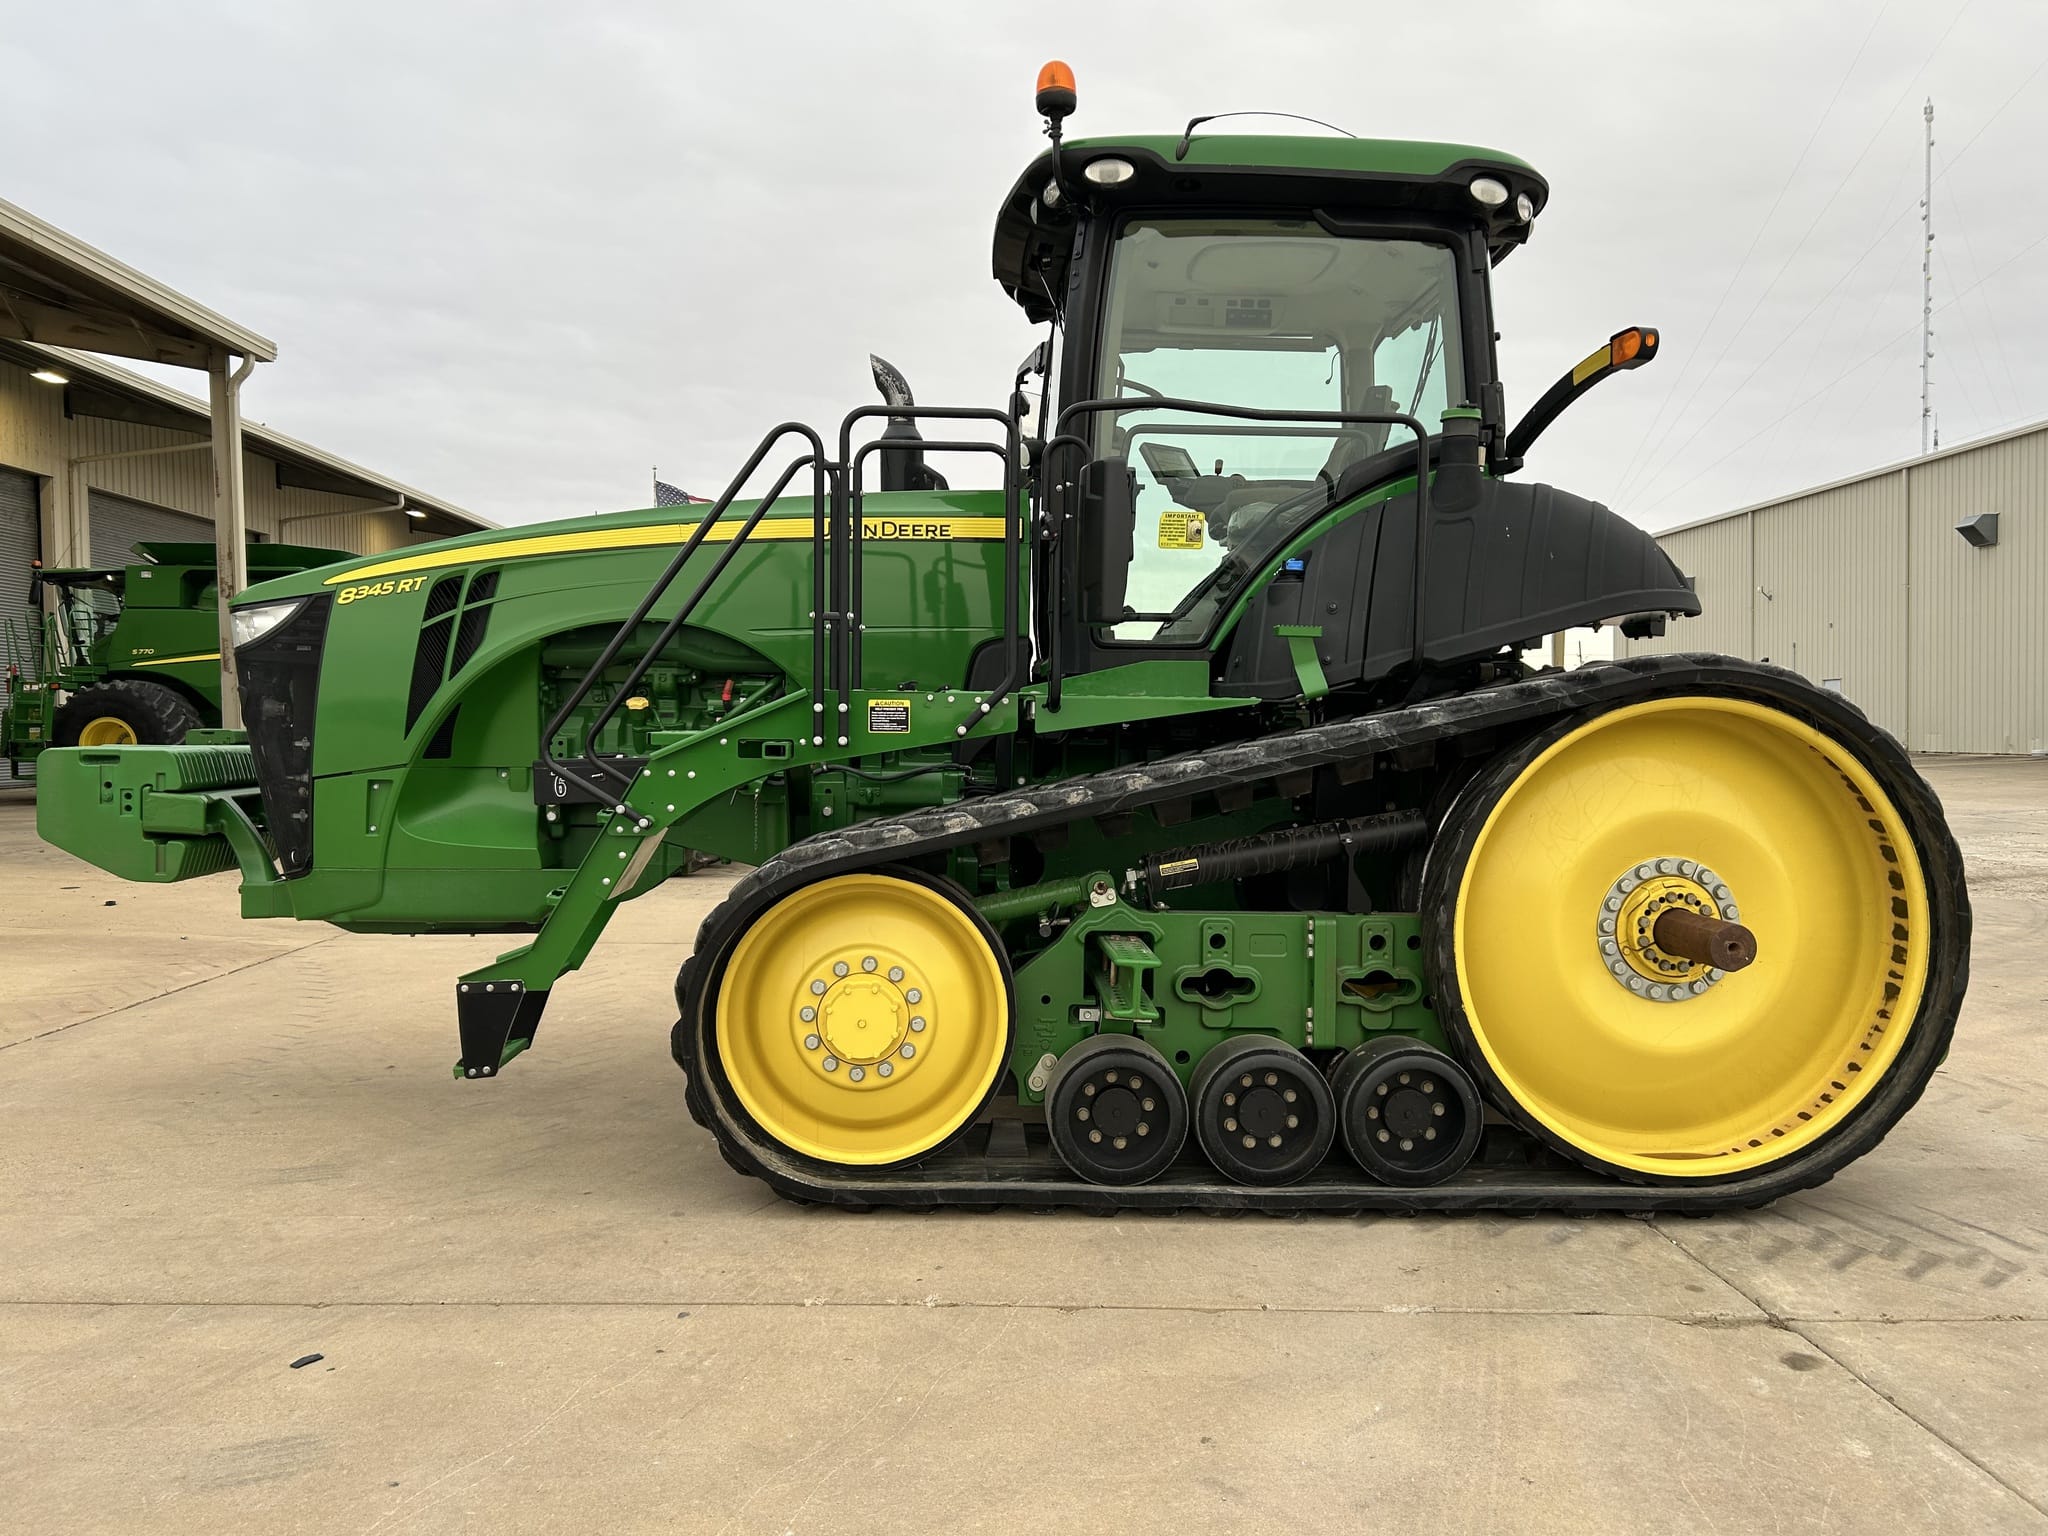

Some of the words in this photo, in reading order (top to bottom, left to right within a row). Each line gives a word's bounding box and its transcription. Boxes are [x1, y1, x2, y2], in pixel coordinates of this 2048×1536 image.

[881, 521, 952, 537] DEERE
[337, 581, 396, 605] 8345
[396, 576, 428, 594] RT
